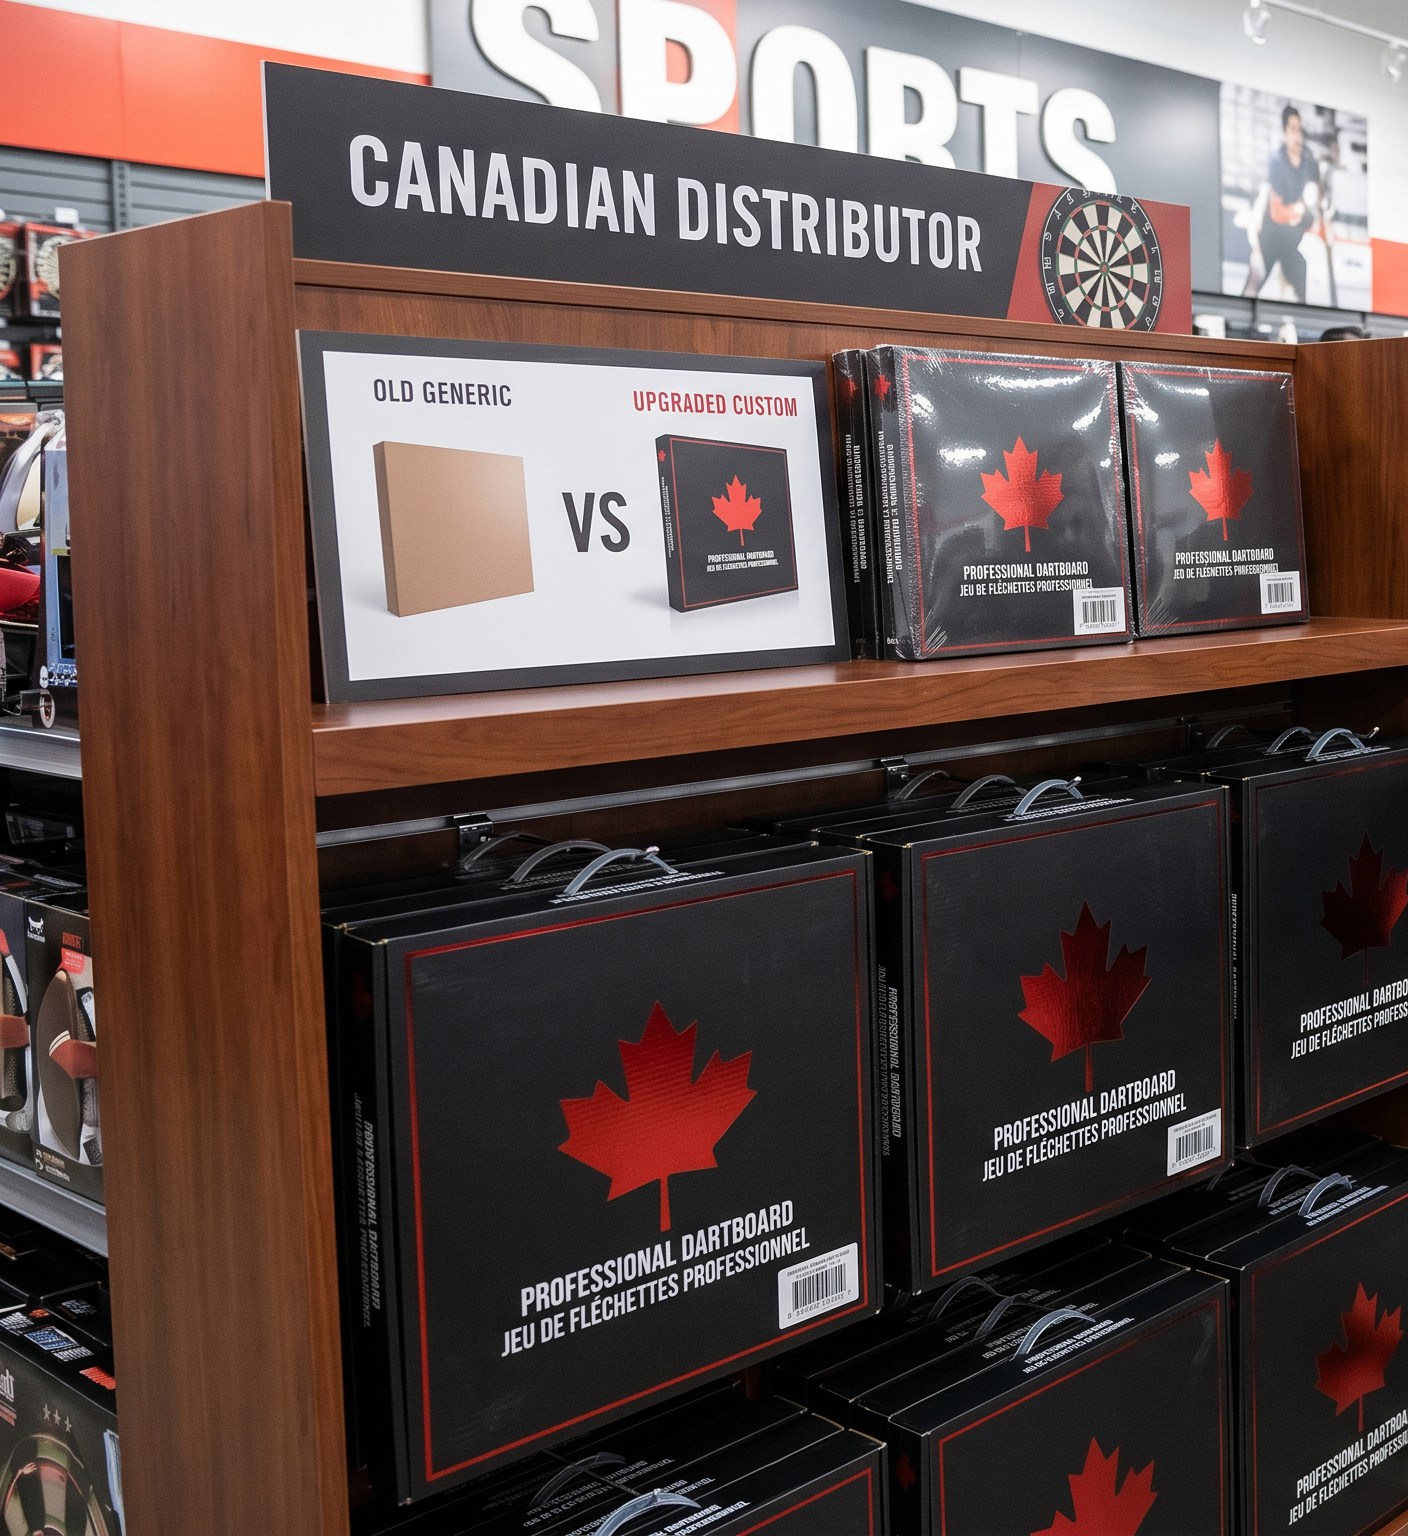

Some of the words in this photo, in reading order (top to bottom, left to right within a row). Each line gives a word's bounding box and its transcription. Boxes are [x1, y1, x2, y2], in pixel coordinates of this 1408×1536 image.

[349, 134, 656, 236] CANADIAN
[677, 178, 983, 272] DISTRIBUTOR
[373, 378, 414, 403] OLD
[422, 380, 512, 407] GENERIC
[633, 390, 727, 414] UPGRADED
[733, 394, 798, 417] CUSTOM
[562, 491, 631, 553] VS
[959, 583, 975, 597] JEU
[963, 563, 1035, 580] PROFESSIONAL
[1290, 1038, 1307, 1060] JEU
[1308, 1034, 1321, 1053] DE
[1322, 1014, 1373, 1048] FLÉCHETTES
[1300, 991, 1371, 1033] PROFESSIONAL
[994, 1096, 1097, 1151] PROFESSIONAL
[1100, 1069, 1176, 1115] DARTBOARD
[982, 1155, 1004, 1182] JEU
[1007, 1149, 1024, 1174] DE
[1026, 1122, 1099, 1167] FLÉCHETTES
[1101, 1092, 1187, 1140] PROFESSIONNEL
[521, 1240, 677, 1317] PROFESSIONAL
[681, 1200, 794, 1261] DARTBOARD
[501, 1325, 535, 1357] JEU
[540, 1316, 565, 1344] DE
[569, 1273, 679, 1334] FLÉCHETTES
[683, 1227, 811, 1292] PROFESSIONNEL
[1296, 1438, 1366, 1499] PROFESSIONAL
[1288, 1501, 1304, 1526] JEU
[1306, 1492, 1318, 1514] DE
